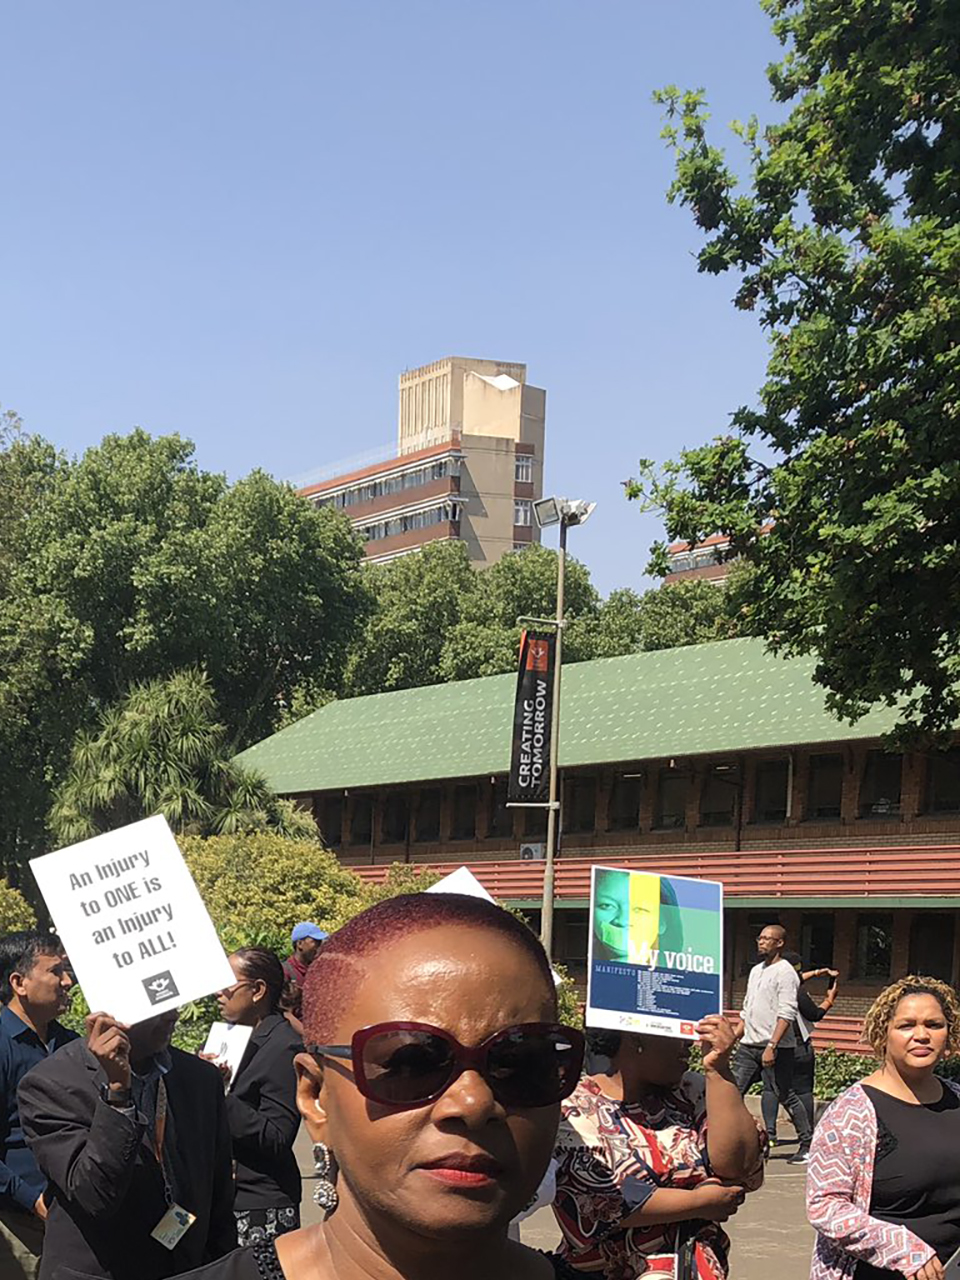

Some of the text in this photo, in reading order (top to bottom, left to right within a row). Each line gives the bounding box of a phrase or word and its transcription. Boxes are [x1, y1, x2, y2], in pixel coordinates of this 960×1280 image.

[518, 700, 534, 787] CREATING
[530, 679, 547, 788] TOMORROW
[70, 850, 150, 890] An Injury
[80, 876, 162, 918] to ONE is
[92, 903, 173, 945] an Injury
[112, 931, 177, 969] to ALL!
[594, 964, 637, 977] MANIFESTO
[663, 946, 715, 975] voice
